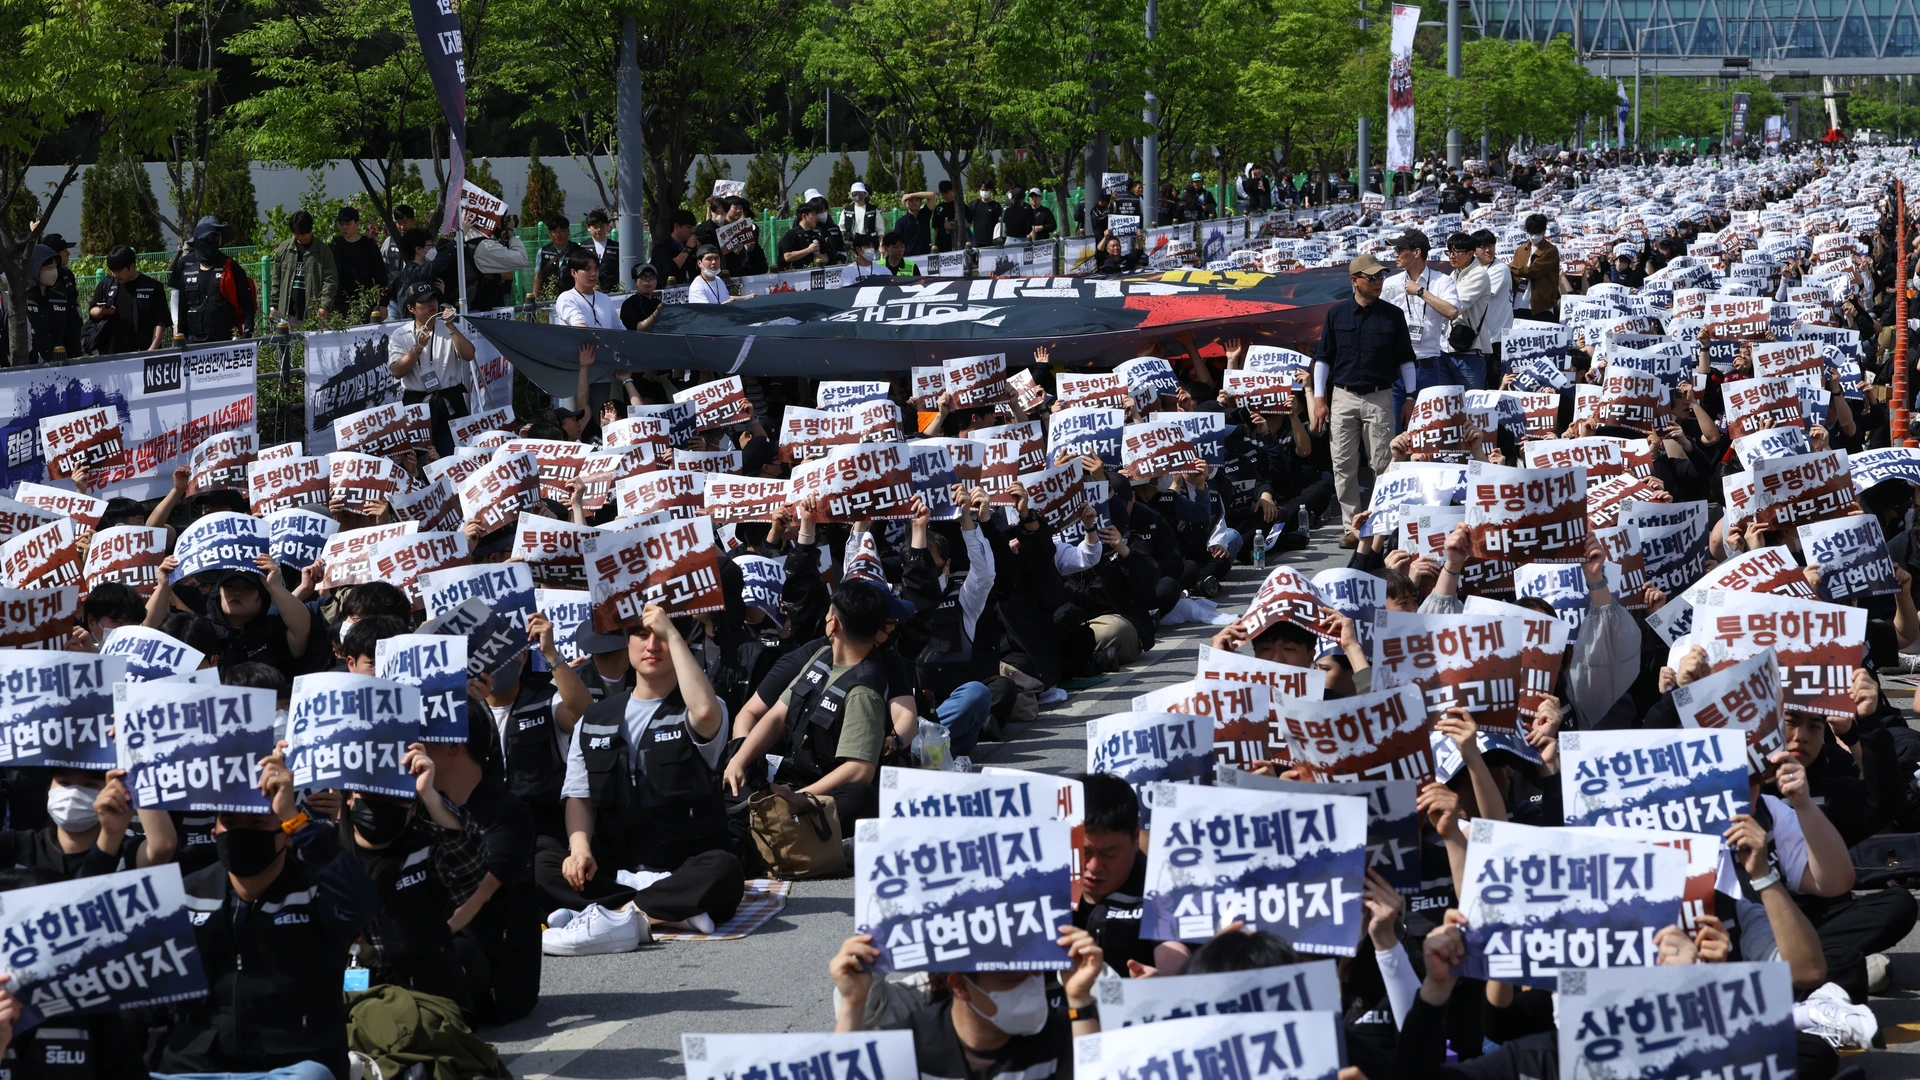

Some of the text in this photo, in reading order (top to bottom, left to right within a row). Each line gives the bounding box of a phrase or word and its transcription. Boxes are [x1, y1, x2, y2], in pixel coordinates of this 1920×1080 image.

[184, 348, 254, 377] 전국삼성전자노동조합
[1249, 353, 1304, 374] 상한폐지
[1759, 343, 1816, 366] 투명하게
[147, 362, 179, 386] NSEU
[949, 363, 1001, 390] 투명하게
[1062, 382, 1120, 401] 투명하게
[1229, 377, 1284, 395] 투명하게
[692, 381, 735, 406] 명하게
[1411, 394, 1465, 428] 투명하게
[1729, 380, 1788, 415] 투명하게
[46, 410, 109, 449] 투명하게
[213, 395, 253, 434] 사수하자!
[340, 410, 397, 440] 투명하게
[788, 415, 854, 438] 투명하게
[1052, 411, 1114, 441] 상한폐지
[7, 428, 33, 468] 참을
[1126, 430, 1185, 458] 투명하게
[253, 463, 320, 497] 투명하게
[465, 458, 534, 505] 투명하게
[1137, 450, 1198, 480] 바꾸고!!!
[1763, 463, 1840, 501] 투명하게
[624, 479, 696, 508] 투명하게
[712, 483, 787, 505] 투명하게
[831, 487, 912, 518] 바꾸고!!!
[1028, 471, 1079, 501] 명하게
[1476, 472, 1578, 515] 투명하게
[483, 488, 540, 527] 바꾸고!!!
[1776, 486, 1853, 526] 바꾸고!!!
[5, 526, 62, 572] 투명하게
[91, 532, 154, 566] 투명하게
[178, 516, 257, 556] 상한폐지
[1486, 524, 1587, 562] 바꾸고!!!
[1812, 527, 1890, 568] 상한폐지
[377, 537, 460, 582] 투명하게
[595, 544, 700, 586] 투명하게
[1721, 553, 1787, 592] 명하게
[617, 566, 718, 627] 바꾸고!!!
[1827, 561, 1897, 602] 실현하자
[1380, 619, 1506, 677] 투명하게
[1715, 612, 1848, 652] 투명하게
[465, 630, 515, 680] 하자
[806, 671, 823, 686] 투쟁
[123, 693, 252, 754] 상한폐지
[294, 686, 402, 736] 상한폐지
[518, 717, 545, 732] SELU
[820, 699, 838, 715] SELU
[1287, 692, 1408, 760] 투명하게
[588, 738, 611, 753] 투쟁
[654, 732, 682, 747] SELU
[135, 752, 264, 807] 실현하자
[294, 742, 410, 788] 실현하자
[1573, 735, 1724, 800] 상한폐지
[1163, 803, 1338, 868] 상한폐지
[395, 870, 426, 889] SELU
[869, 828, 1043, 899] 상한폐지
[1475, 853, 1657, 912] 상한폐지
[2, 876, 160, 968] 상한폐지
[274, 914, 309, 926] SELU
[1106, 910, 1142, 925] SELU
[1410, 899, 1449, 918] SELU
[885, 894, 1070, 970] 실현하자
[1484, 925, 1660, 980] 실현하자
[30, 938, 192, 1018] 실현하자
[1573, 970, 1768, 1063] 상한폐지
[45, 1051, 85, 1065] SELU
[1097, 1020, 1308, 1080] 한폐지
